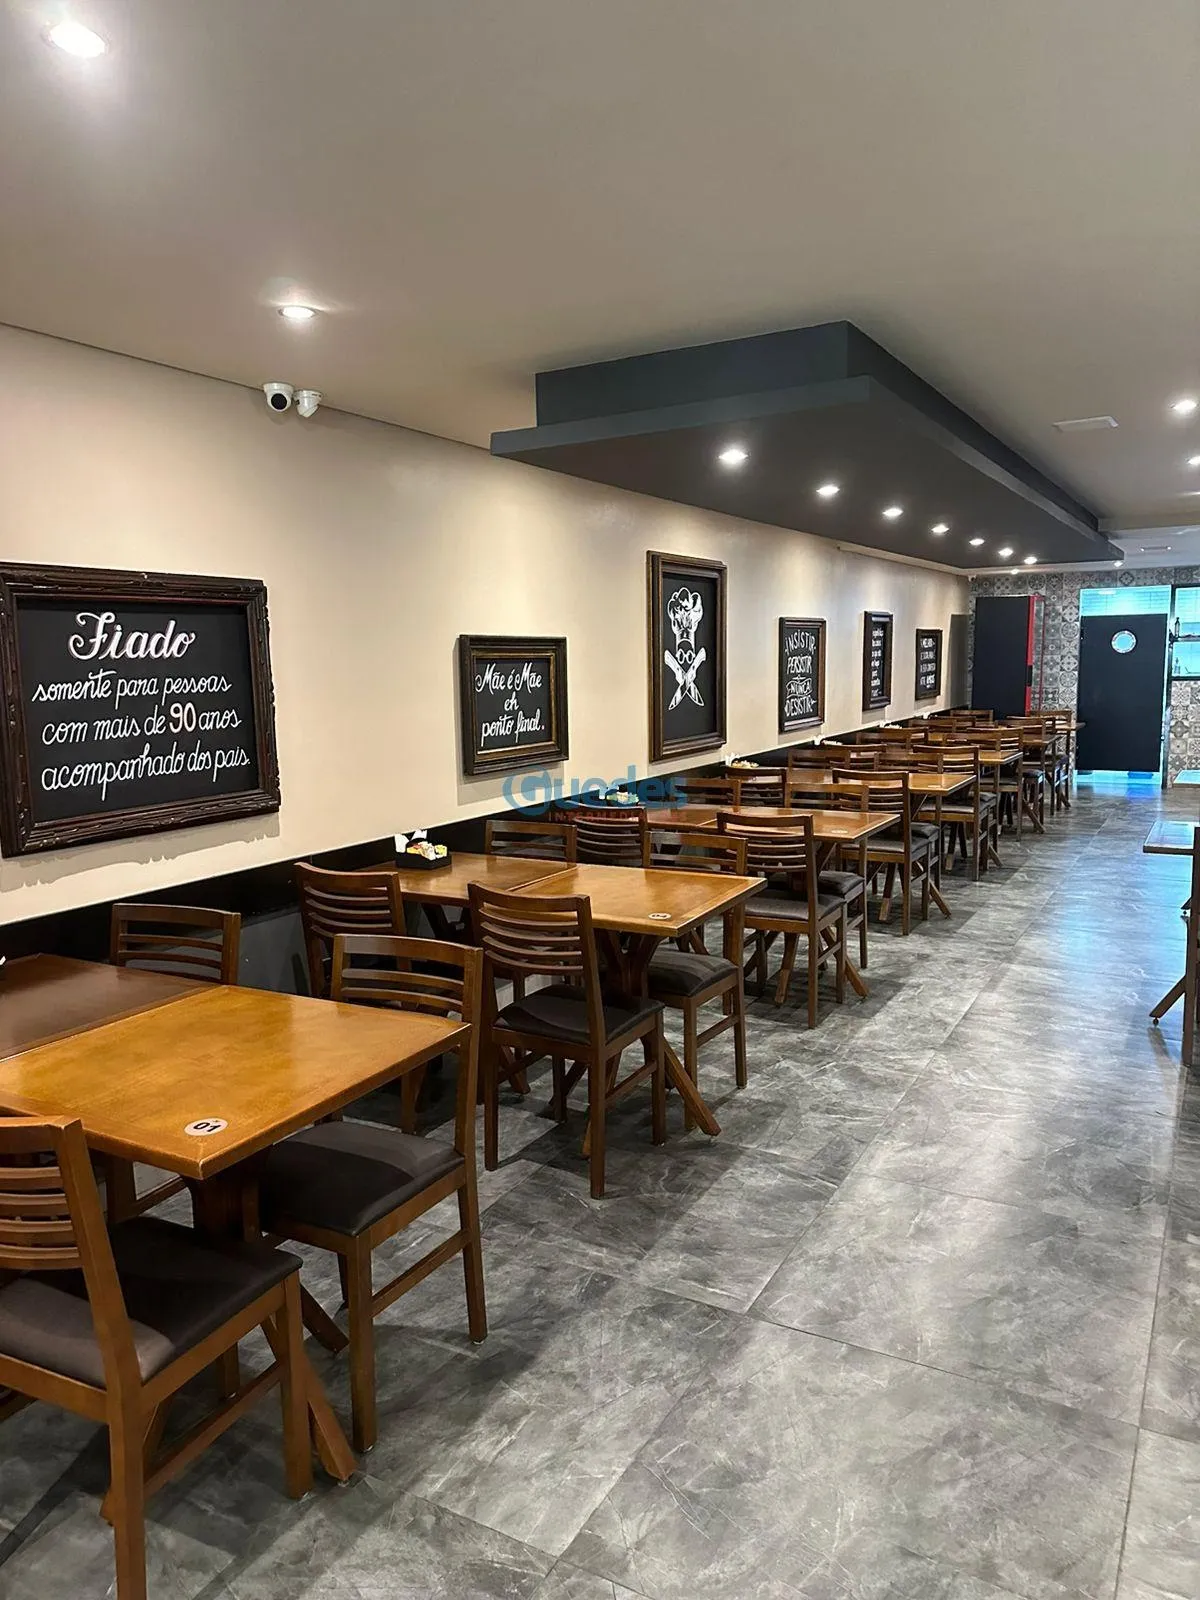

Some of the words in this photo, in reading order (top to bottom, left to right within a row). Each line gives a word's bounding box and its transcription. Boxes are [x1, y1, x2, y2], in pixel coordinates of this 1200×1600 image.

[69, 611, 195, 660] Fiado
[32, 668, 117, 702] somente
[116, 676, 158, 710] para
[162, 675, 233, 706] pessoas
[474, 663, 506, 695] Mãe
[506, 669, 516, 690] é
[514, 662, 542, 694] Mãe
[42, 722, 88, 745] com
[93, 714, 141, 740] mais
[144, 704, 166, 735] de
[169, 702, 196, 734] 90
[199, 708, 242, 731] anos
[480, 714, 515, 748] ponto
[514, 708, 545, 743] final.
[41, 742, 186, 801] acompanhado
[187, 740, 212, 772] dos
[213, 746, 250, 782] pais.
[193, 1122, 221, 1132] 01
